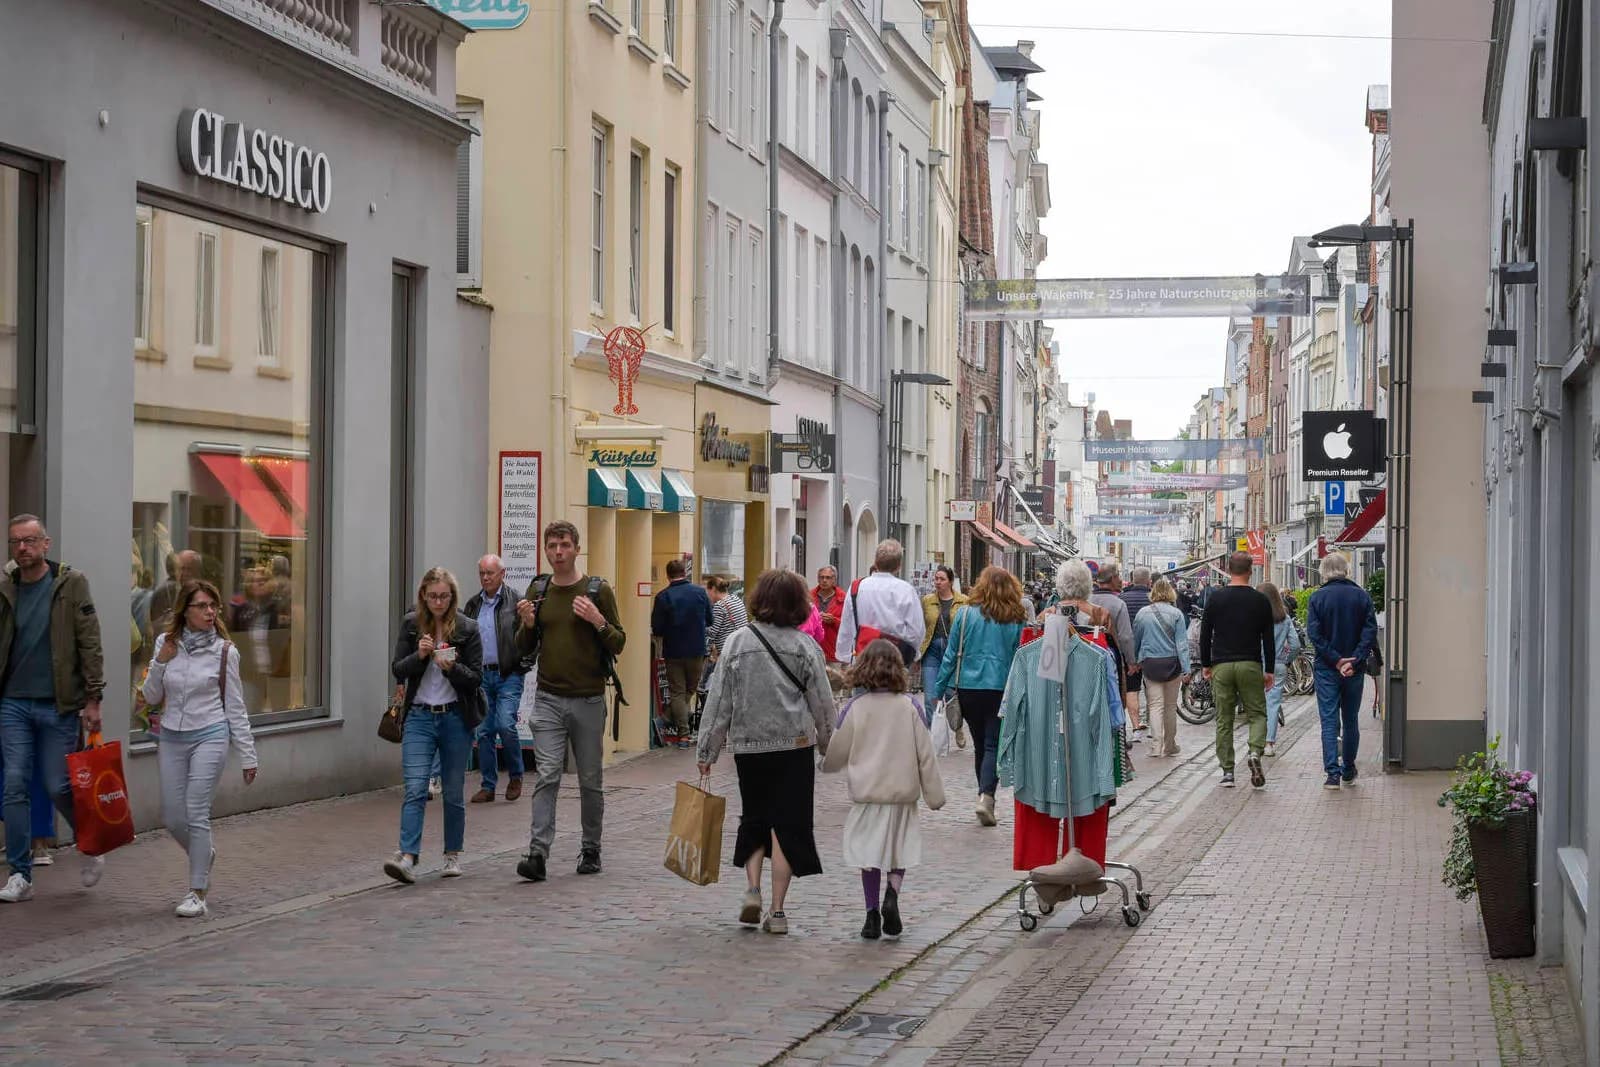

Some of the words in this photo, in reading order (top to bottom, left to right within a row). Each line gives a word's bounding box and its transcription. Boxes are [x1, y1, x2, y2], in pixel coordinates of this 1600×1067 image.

[189, 107, 332, 215] CLASSICO
[997, 290, 1038, 302] Unsere
[1041, 288, 1095, 301] Wakenitz
[1109, 288, 1123, 300] 25
[1126, 288, 1157, 301] Jahre
[1159, 287, 1269, 302] Naturschutzgebiet
[1092, 446, 1125, 454] Museum
[504, 460, 515, 468] Sie
[516, 460, 536, 468] haben
[1307, 469, 1340, 477] Premium
[1340, 469, 1369, 477] Reseller
[1329, 483, 1341, 511] P
